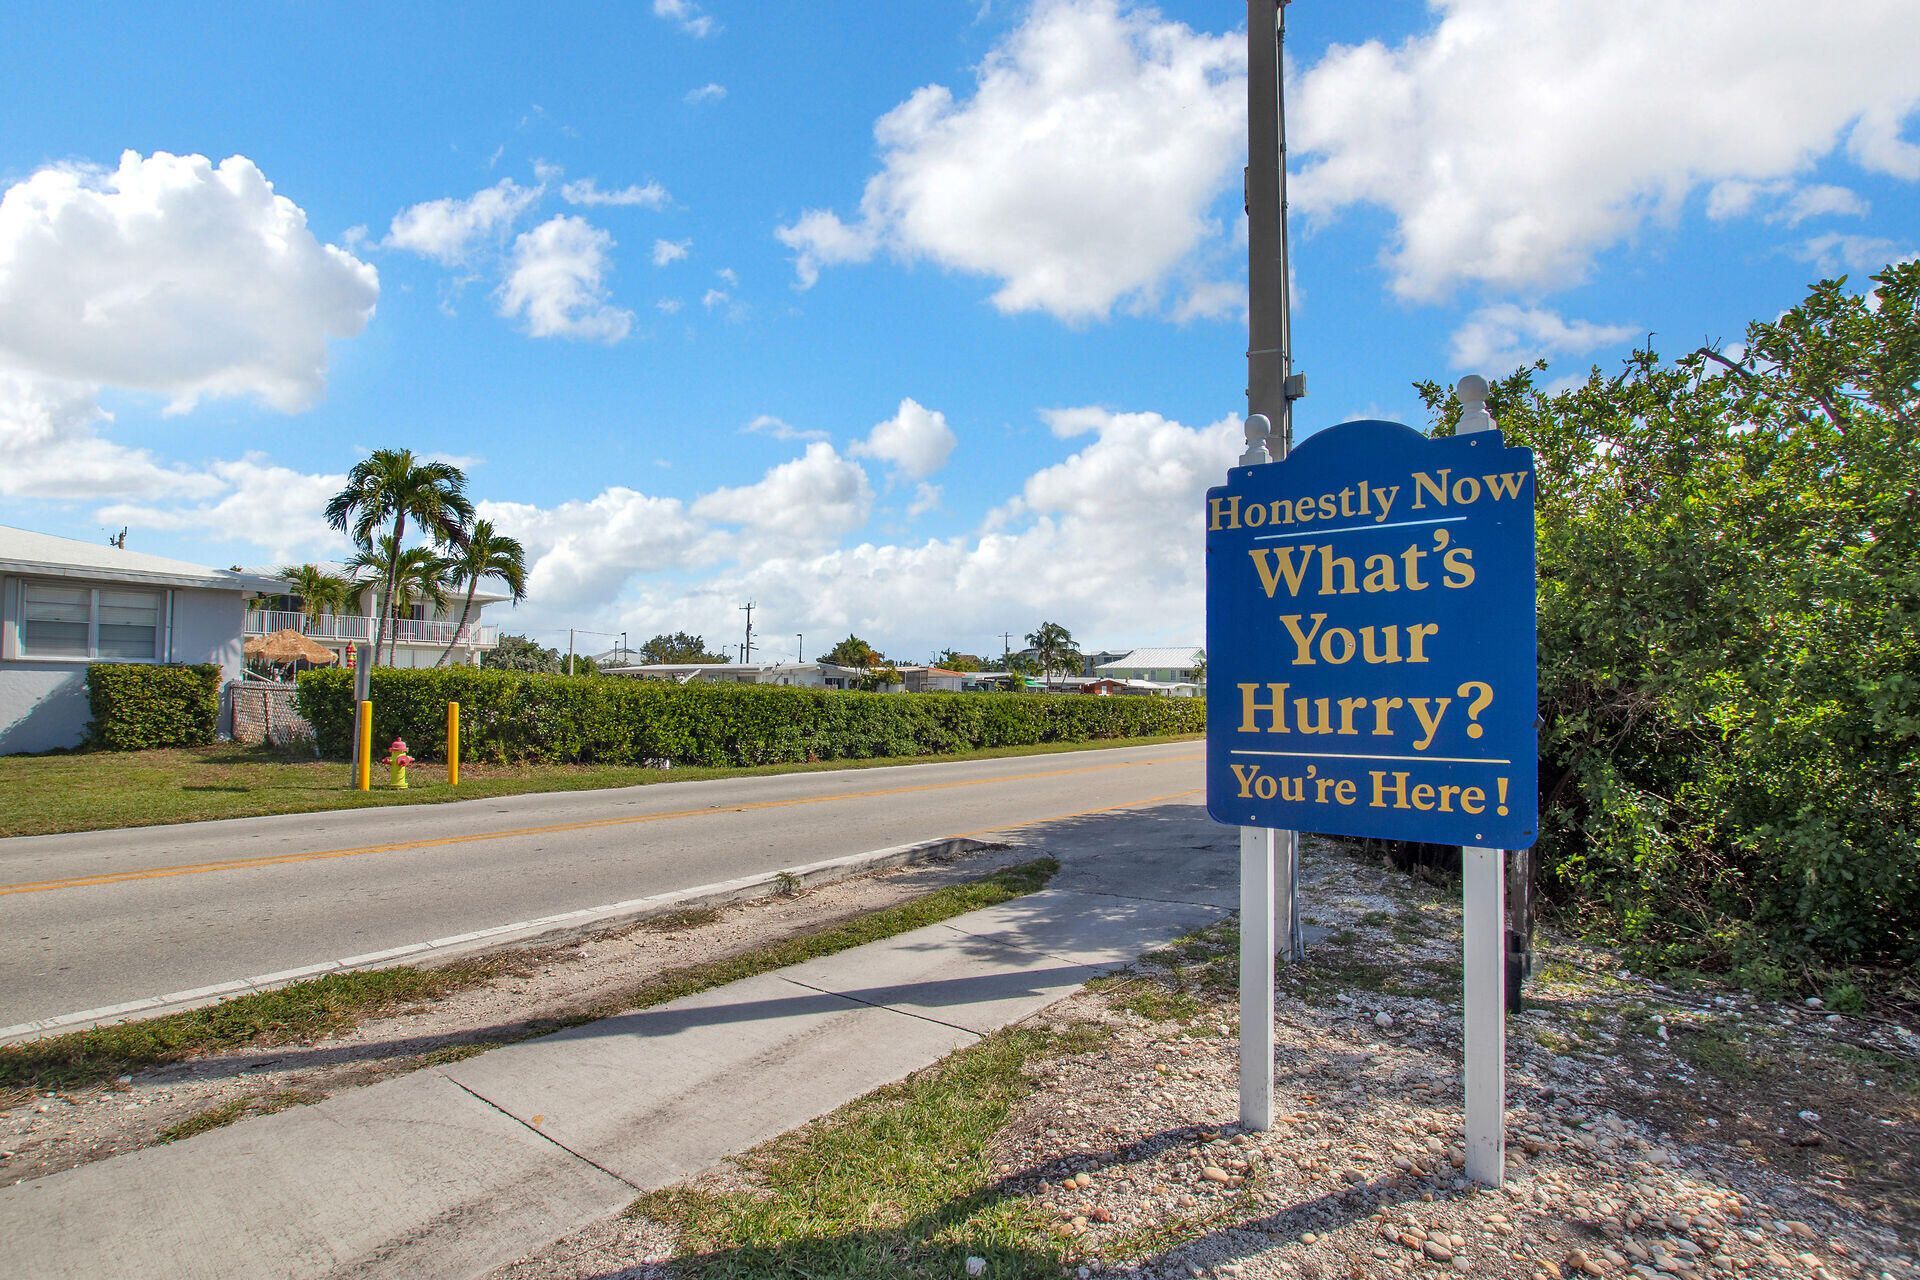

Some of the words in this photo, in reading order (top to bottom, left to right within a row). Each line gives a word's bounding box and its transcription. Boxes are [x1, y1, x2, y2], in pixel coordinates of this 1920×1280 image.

[1208, 480, 1400, 531] Honestly
[1411, 468, 1529, 510] Now
[1248, 528, 1476, 598] What's
[1279, 613, 1439, 665] Your
[1236, 681, 1494, 751] Hurry?
[1230, 764, 1357, 805] You're
